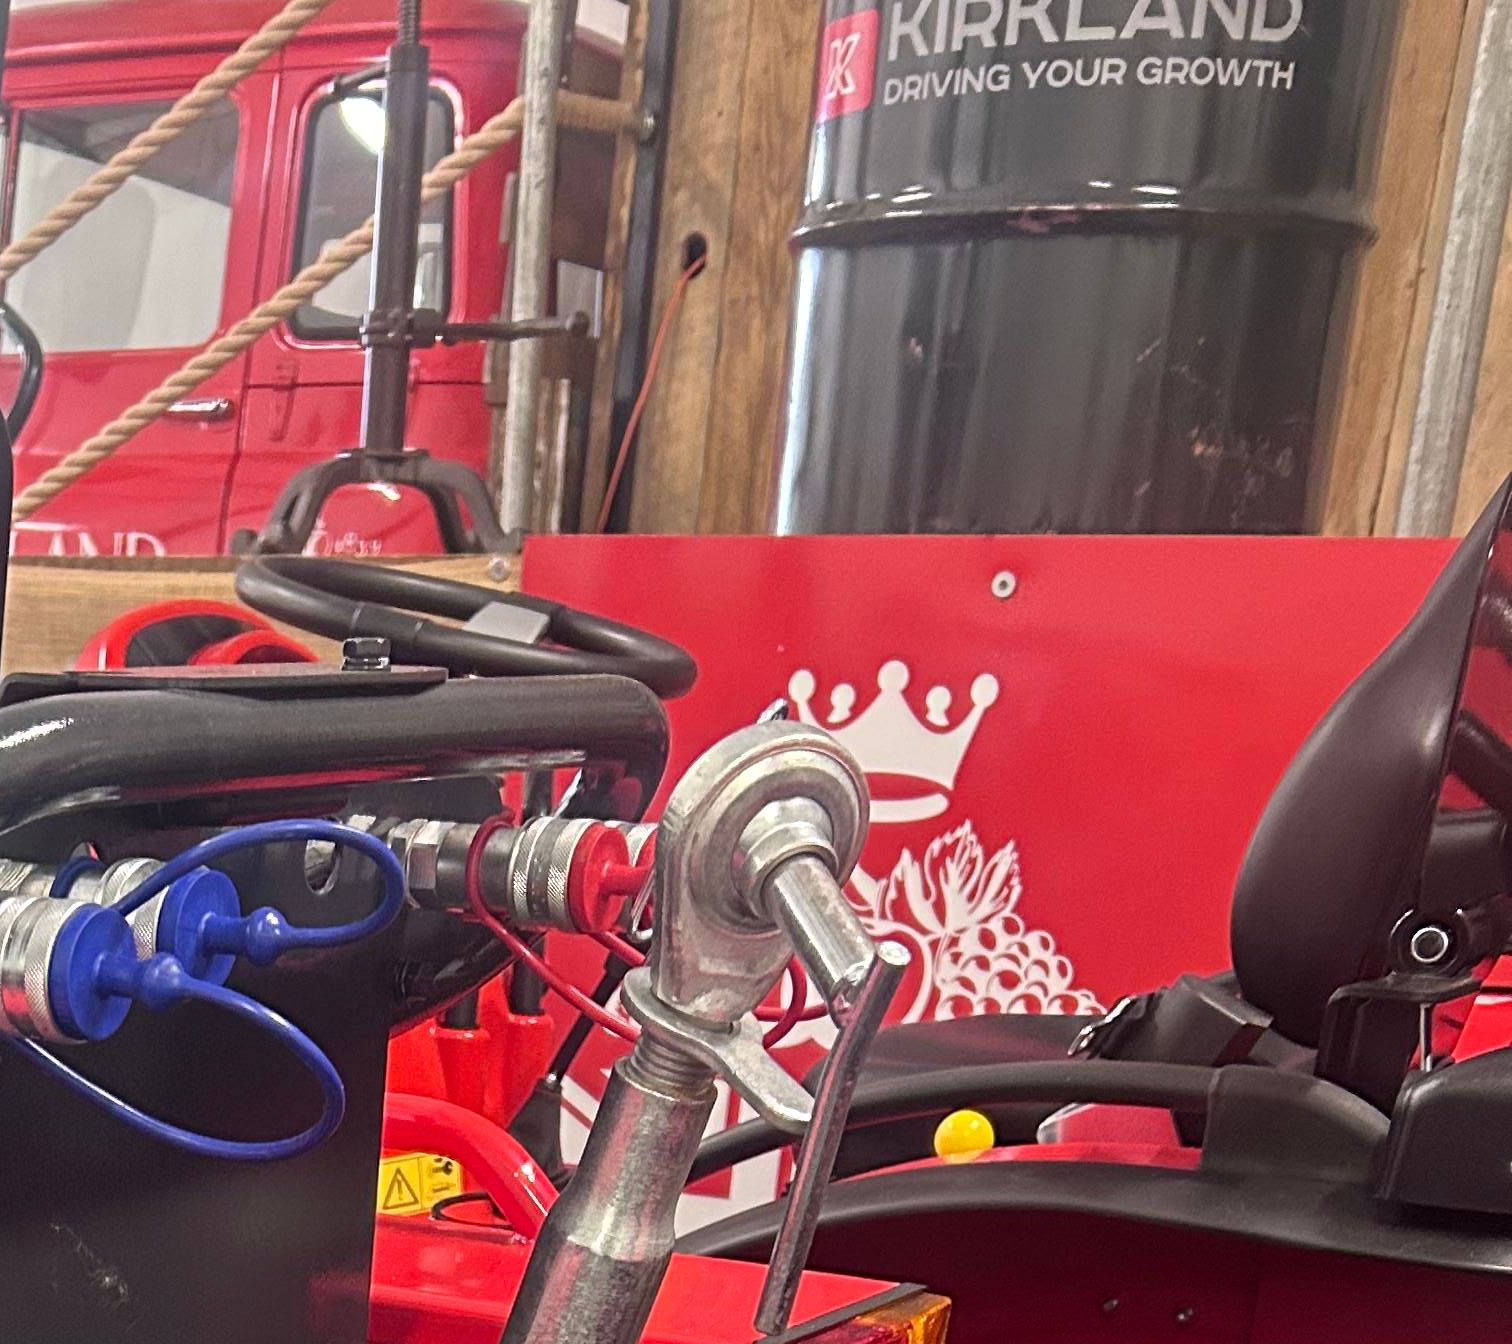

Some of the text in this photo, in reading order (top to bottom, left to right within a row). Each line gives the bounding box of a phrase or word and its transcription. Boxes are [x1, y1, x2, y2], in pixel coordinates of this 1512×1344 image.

[888, 0, 1303, 62] KIRKLAND
[883, 56, 1297, 106] DRIVING YOUR GROWTH
